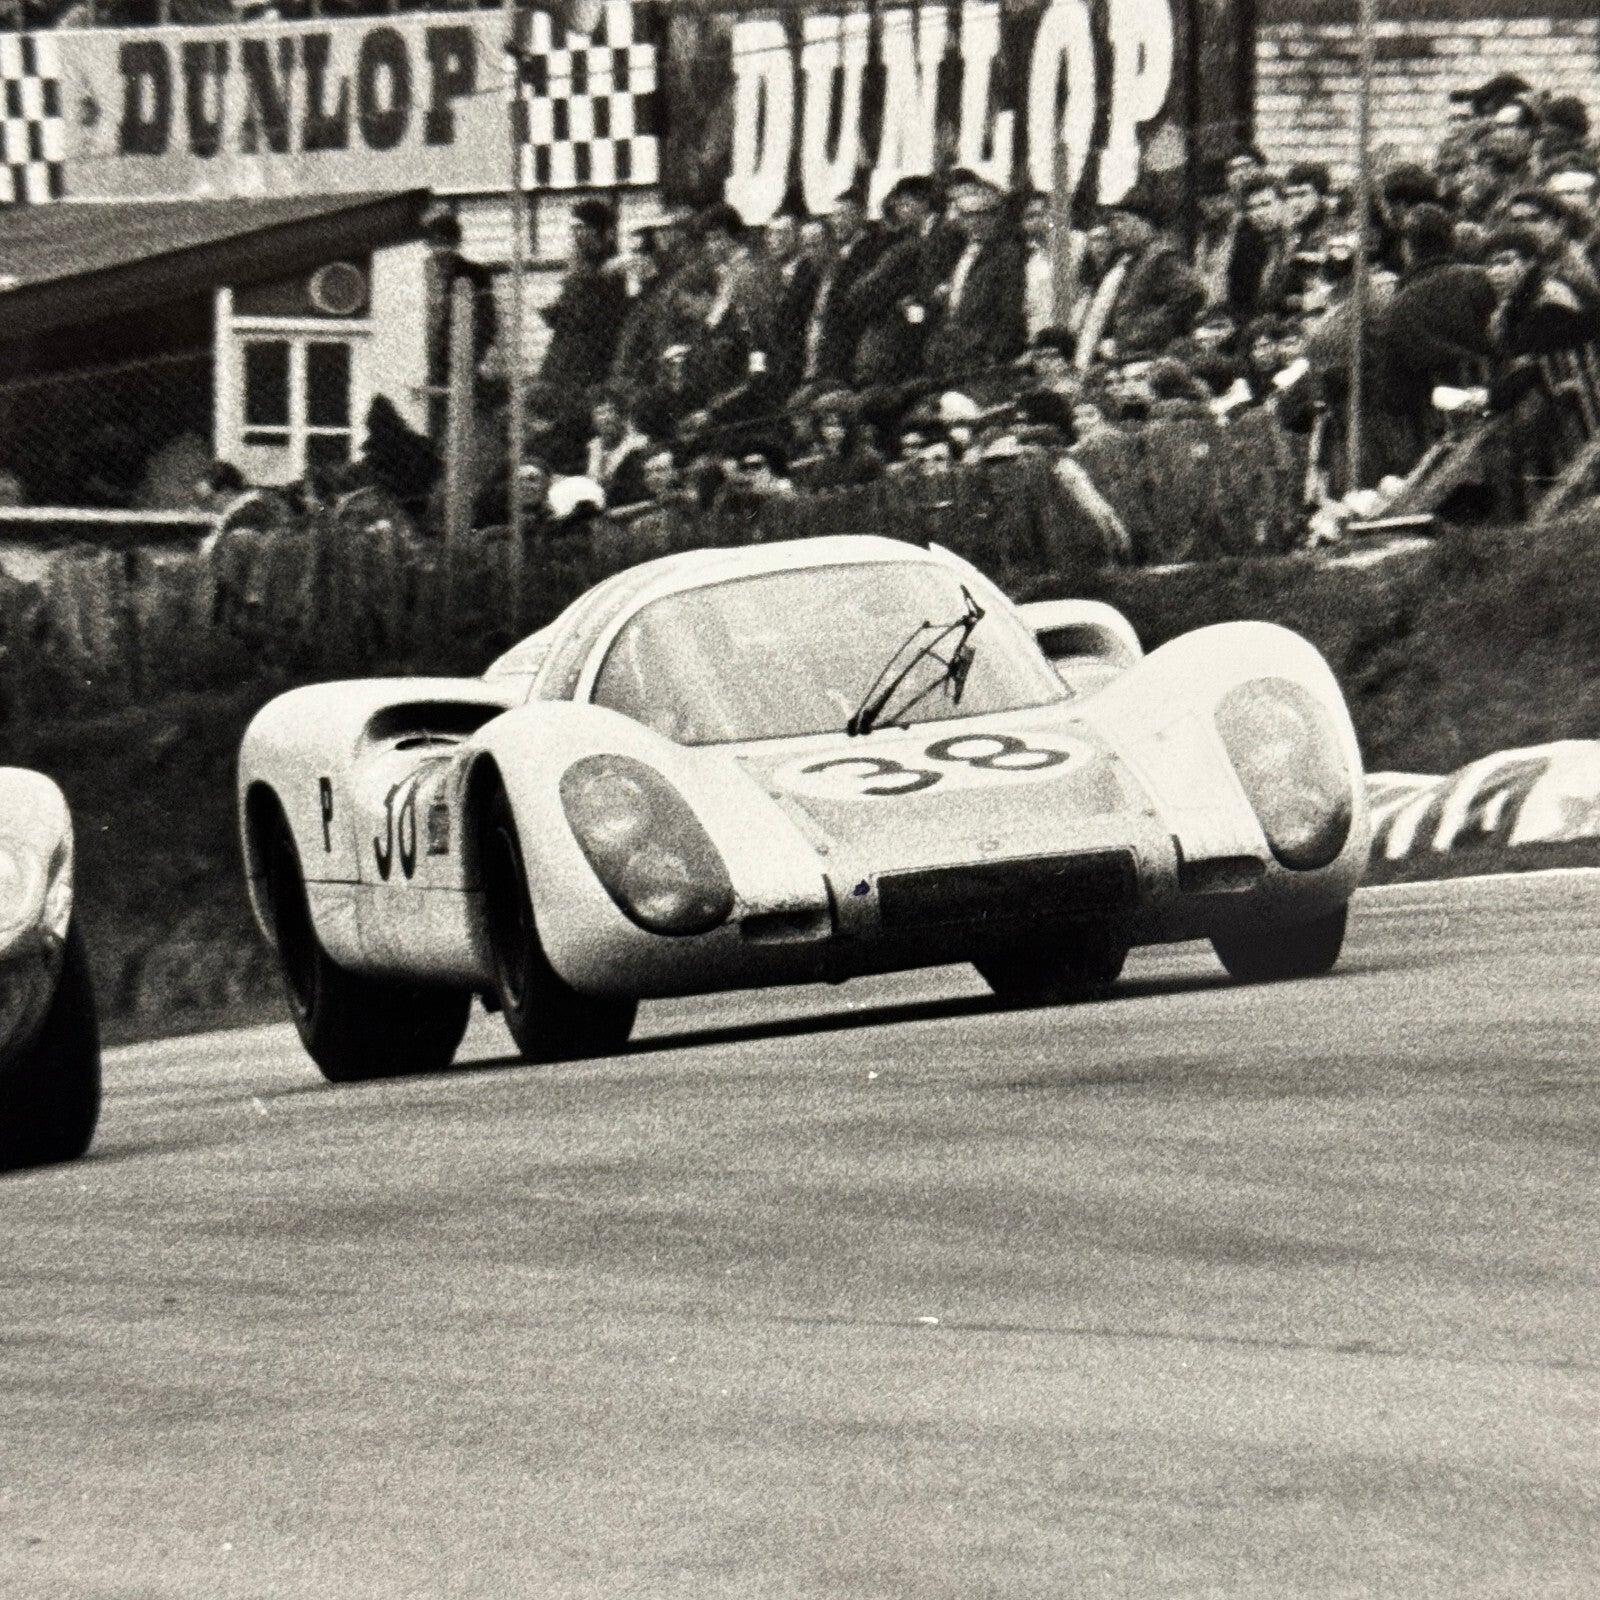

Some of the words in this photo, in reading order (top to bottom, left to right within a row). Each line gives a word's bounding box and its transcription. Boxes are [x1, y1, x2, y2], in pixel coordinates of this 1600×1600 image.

[118, 26, 475, 158] DUNLOP
[725, 0, 1173, 225] DUNLOP
[319, 776, 333, 853] P
[801, 733, 1070, 796] 38
